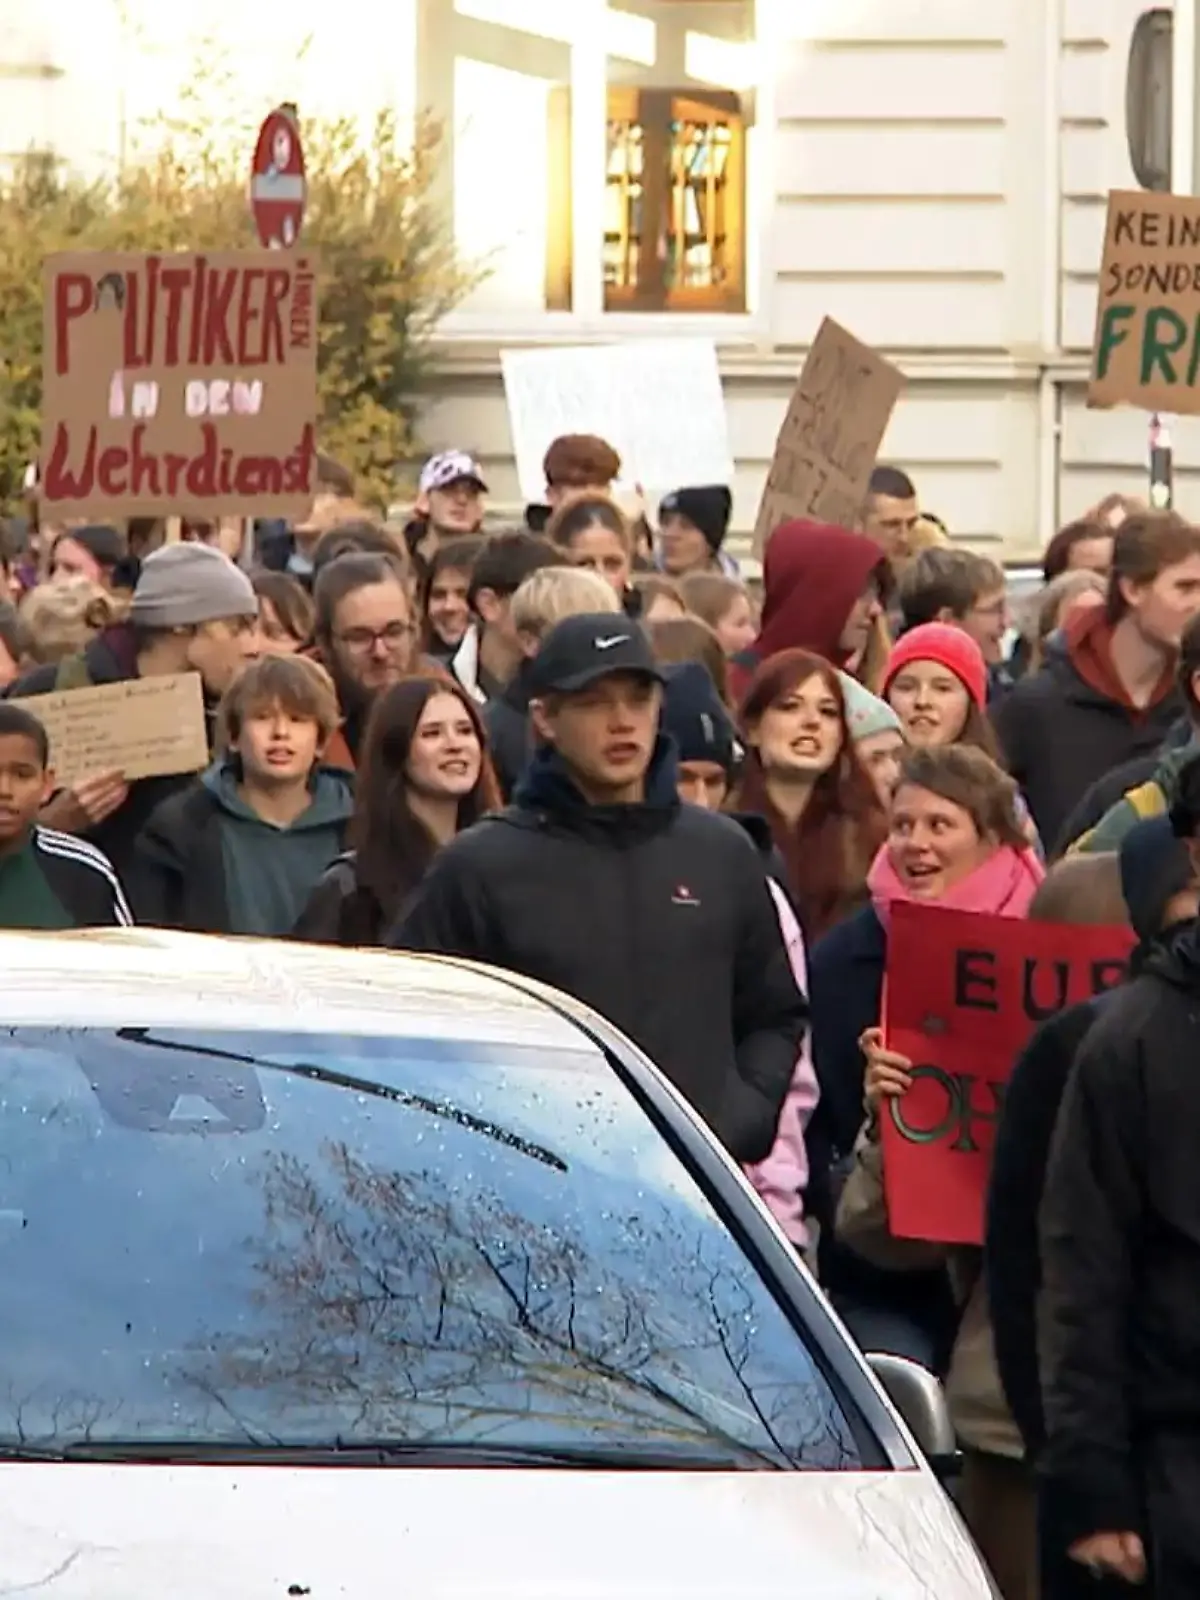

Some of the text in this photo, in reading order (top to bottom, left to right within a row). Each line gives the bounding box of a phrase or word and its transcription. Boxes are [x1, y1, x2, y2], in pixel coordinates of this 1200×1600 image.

[1114, 209, 1200, 248] KEIN
[185, 378, 263, 418] DEN
[45, 421, 314, 501] Wehrdienst
